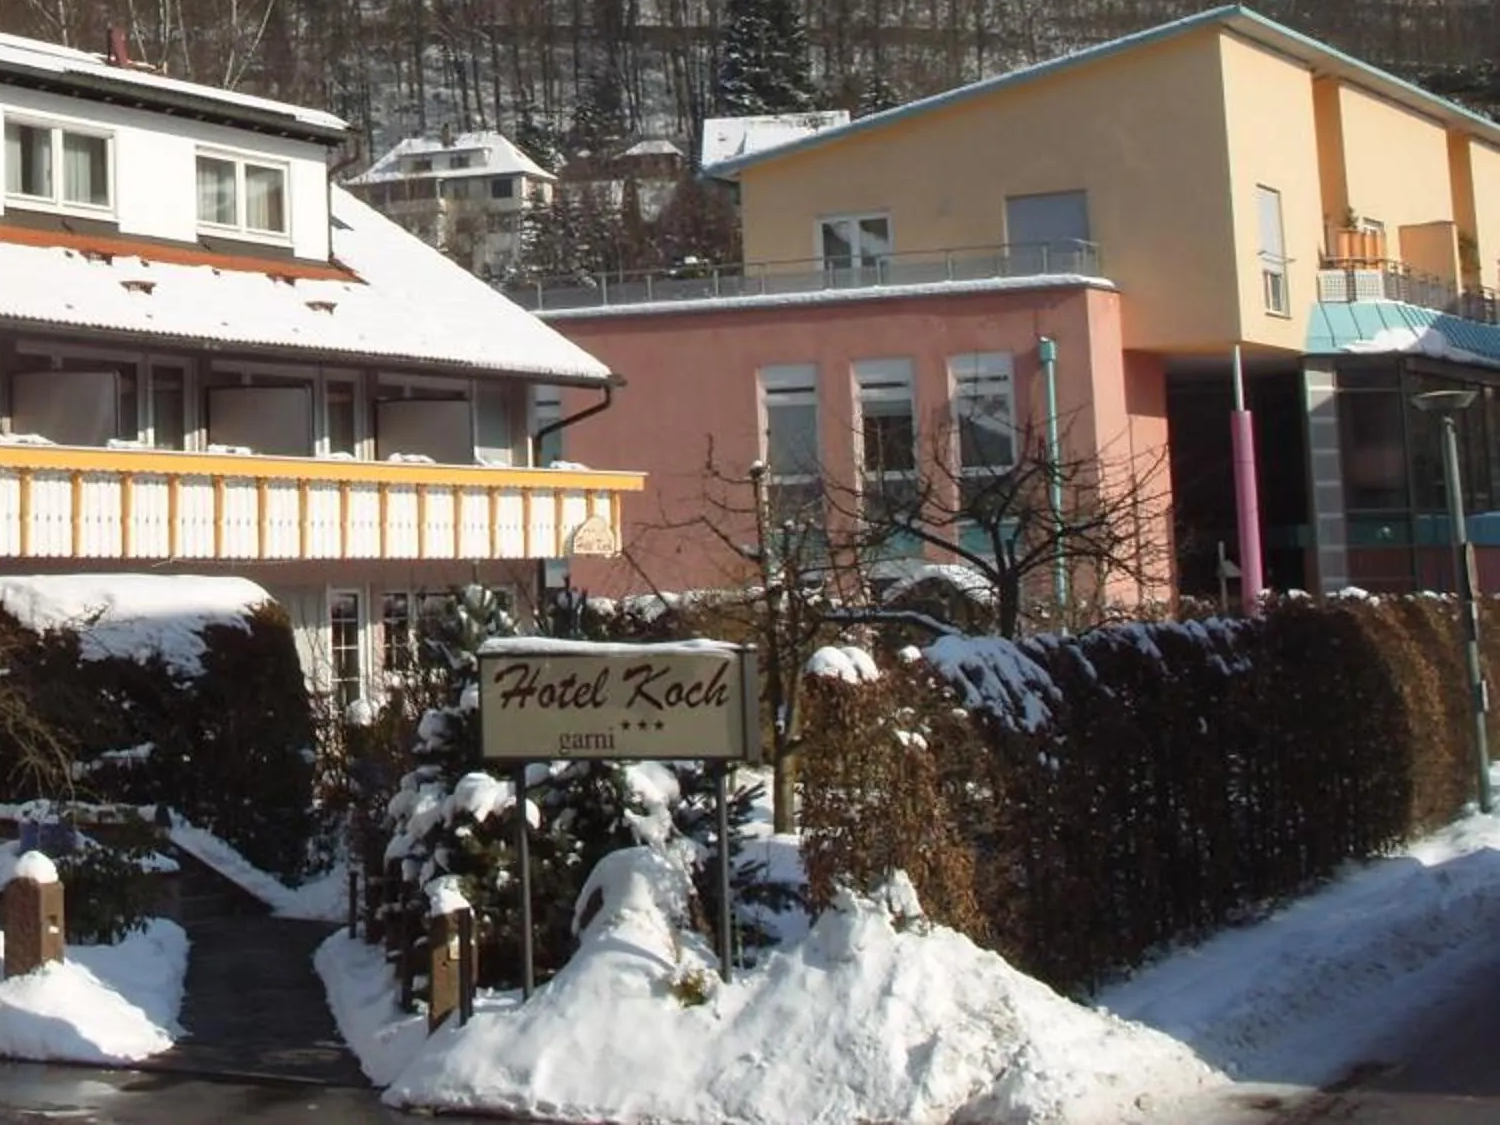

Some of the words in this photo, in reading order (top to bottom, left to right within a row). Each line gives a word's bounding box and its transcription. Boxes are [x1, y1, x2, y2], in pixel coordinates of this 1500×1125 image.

[494, 663, 609, 709] Hotel
[622, 660, 731, 710] Koch
[558, 727, 615, 754] garni
